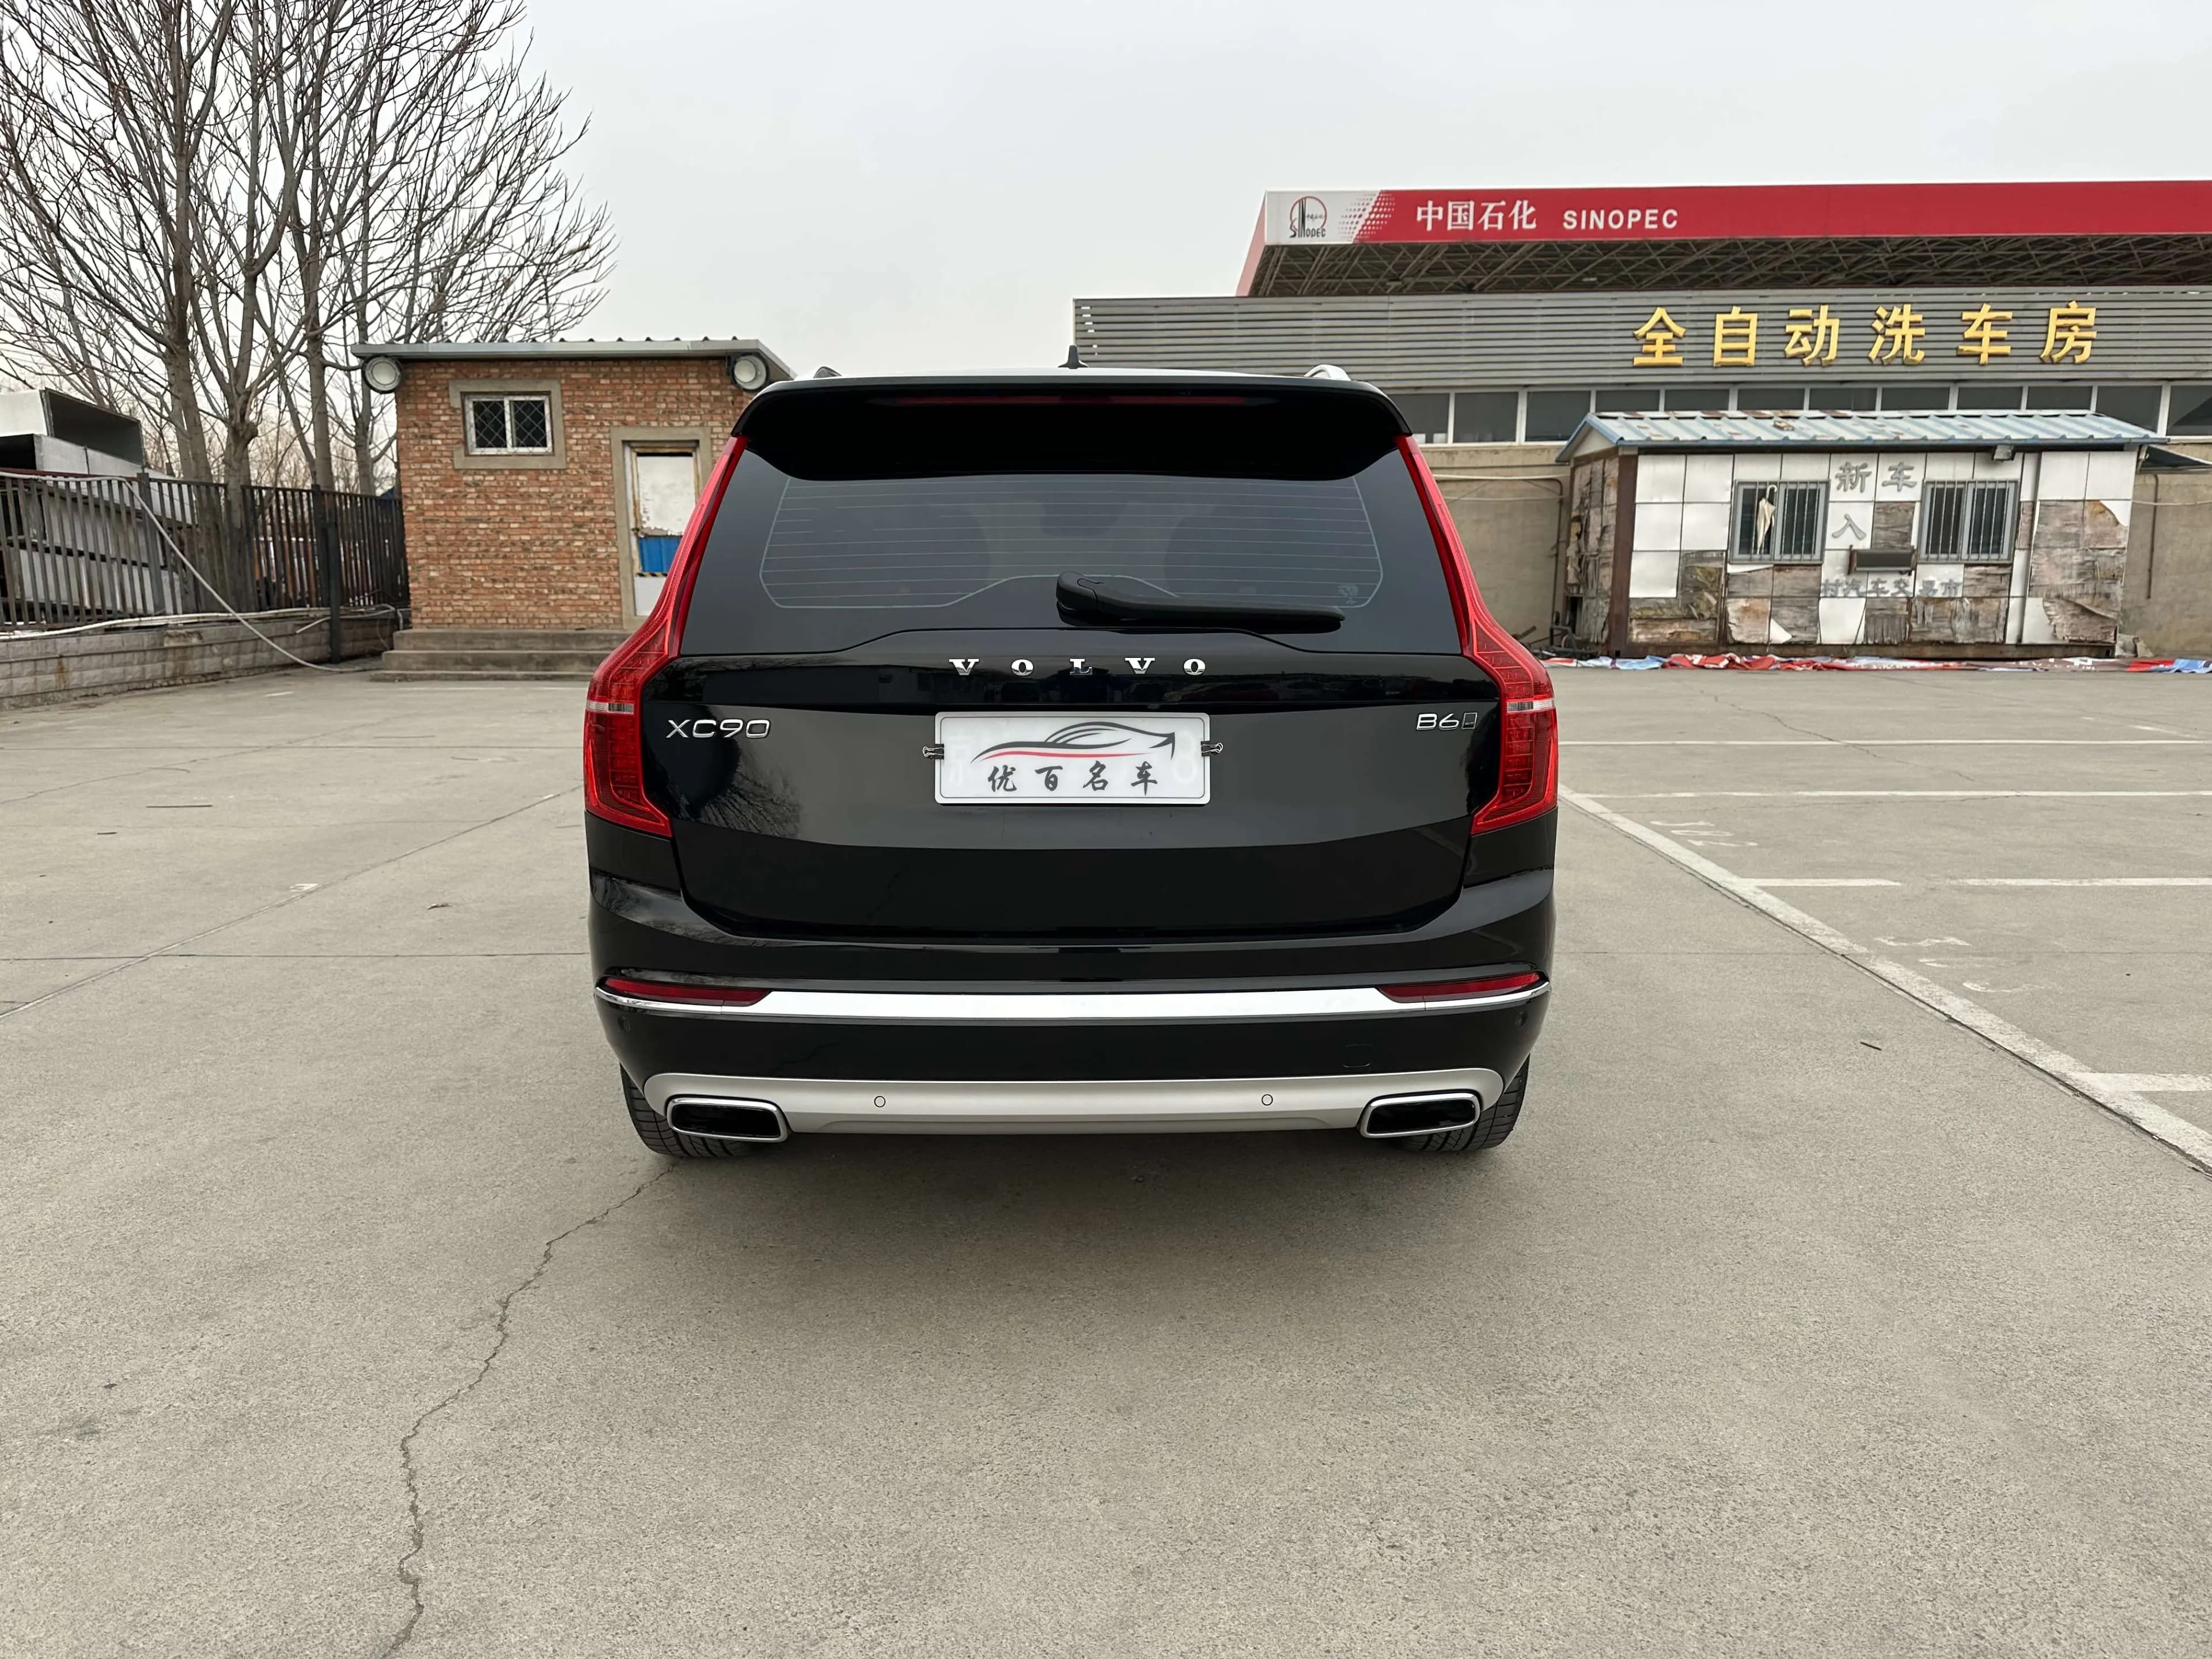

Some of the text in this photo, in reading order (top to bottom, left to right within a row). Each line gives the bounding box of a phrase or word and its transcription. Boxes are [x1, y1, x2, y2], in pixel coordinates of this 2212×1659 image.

[1416, 200, 1537, 231] 中国石化
[1563, 209, 1678, 229] SINOPEC
[1633, 301, 2098, 366] 全自动洗车房
[1835, 461, 1918, 493] 新车
[949, 657, 1206, 676] VOLVO
[665, 719, 770, 738] XC90
[1416, 713, 1459, 730] B6
[987, 760, 1158, 796] 优百名车
